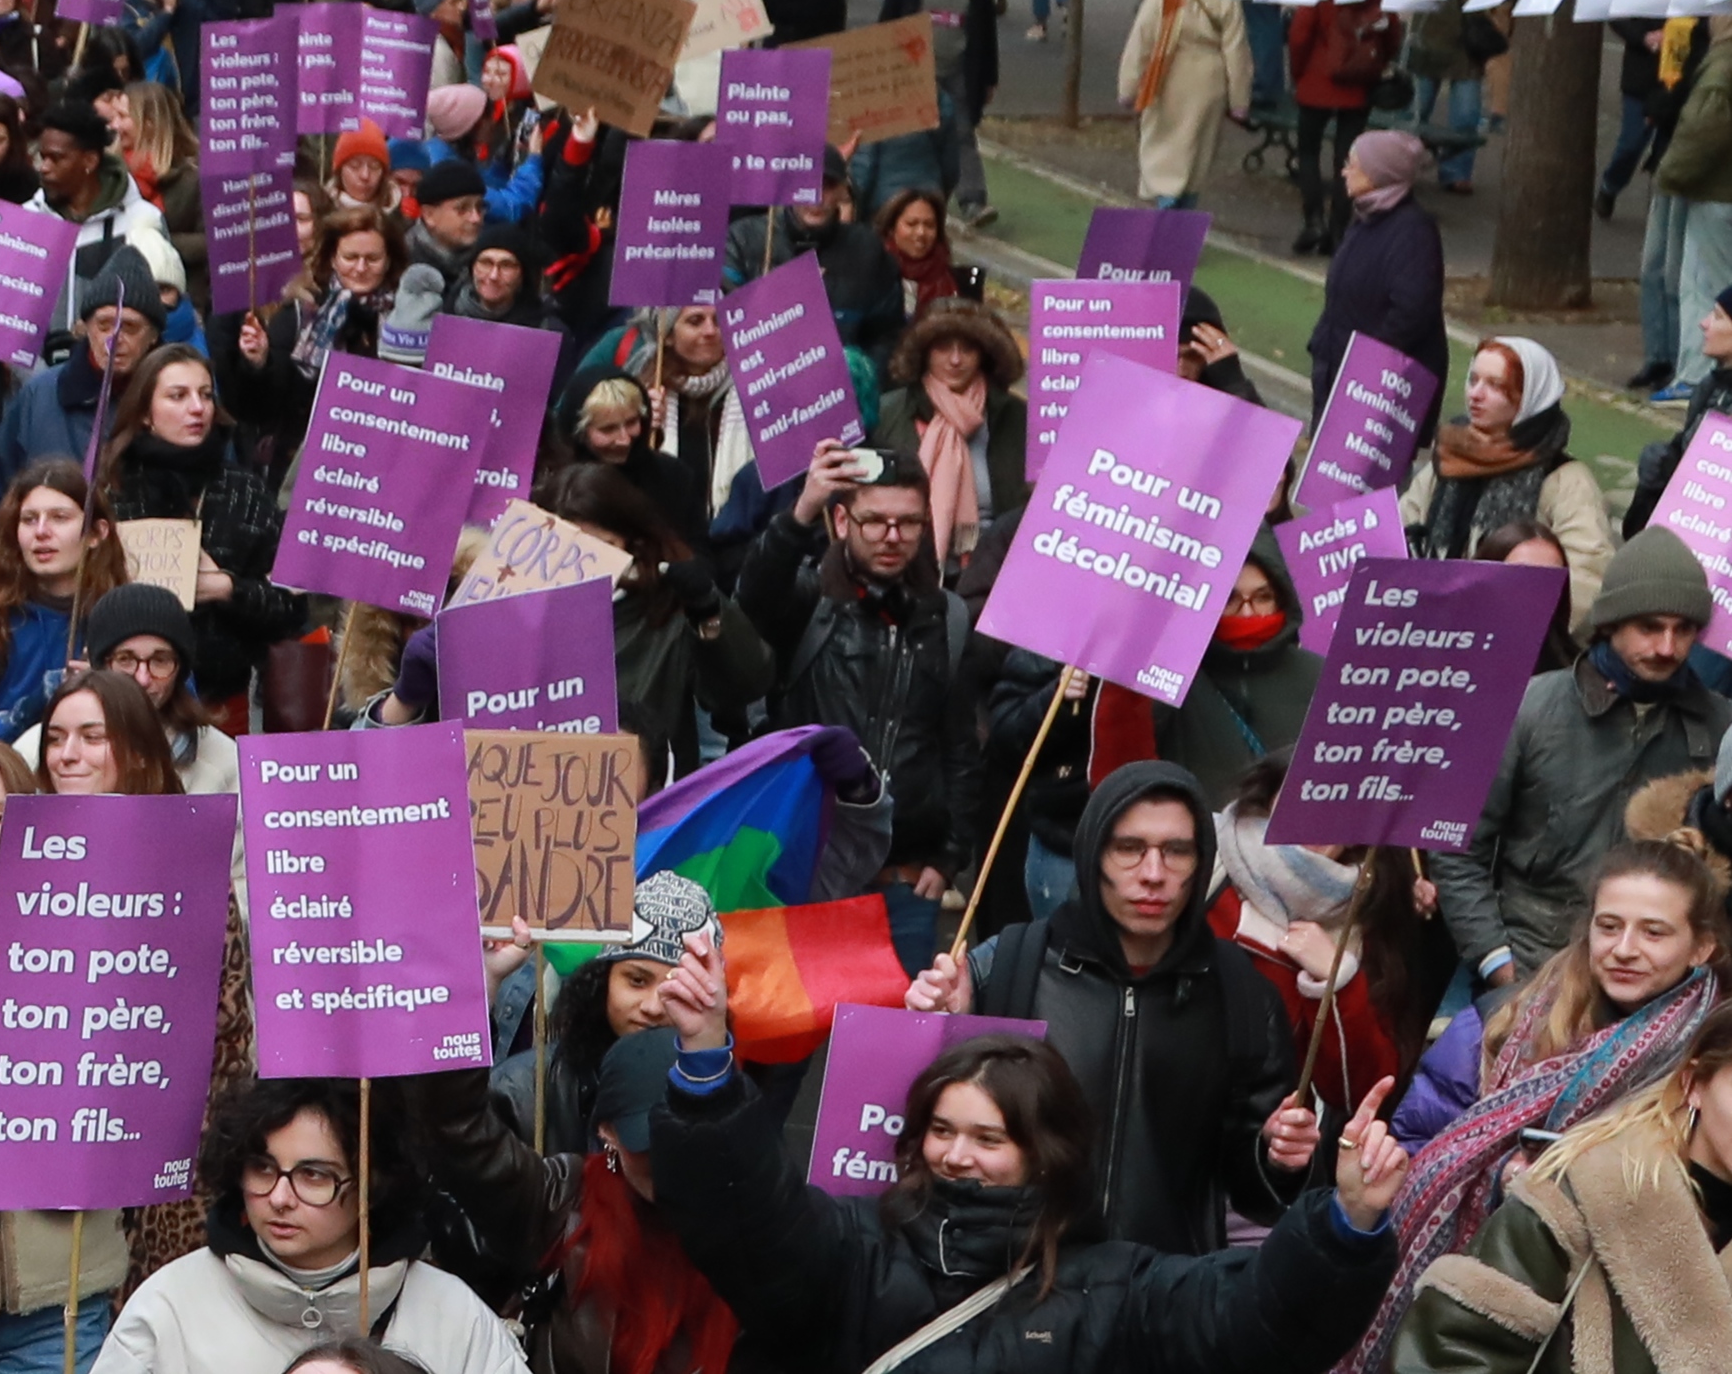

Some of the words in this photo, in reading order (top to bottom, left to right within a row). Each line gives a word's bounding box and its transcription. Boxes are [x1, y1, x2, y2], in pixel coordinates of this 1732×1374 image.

[728, 83, 789, 100] Plainte
[726, 111, 749, 123] ou
[755, 111, 792, 127] pas,
[654, 190, 700, 205] Mères
[647, 217, 700, 232] isolées
[625, 244, 714, 261] précarisées
[1088, 449, 1170, 497] Pour
[1178, 487, 1220, 519] un
[1050, 483, 1222, 569] féminisme
[1033, 528, 1211, 611] décolonial
[261, 761, 320, 783] Pour
[328, 764, 357, 780] un
[540, 748, 635, 809] JOUR
[264, 798, 449, 828] consentement
[534, 807, 620, 852] PLUS
[22, 827, 85, 860] Les
[267, 850, 324, 873] libre
[17, 882, 163, 917] violeurs
[270, 895, 351, 919] éclairé
[8, 943, 73, 972] ton
[88, 944, 177, 983] pote,
[273, 939, 402, 964] réversible
[276, 989, 303, 1009] et
[312, 985, 448, 1014] spécifique
[2, 999, 68, 1028] ton
[82, 998, 170, 1039] père,
[433, 1043, 482, 1061] toutes
[443, 1033, 481, 1047] nous
[77, 1052, 169, 1088] frère,
[164, 1158, 190, 1172] nous
[154, 1170, 189, 1189] toutes
